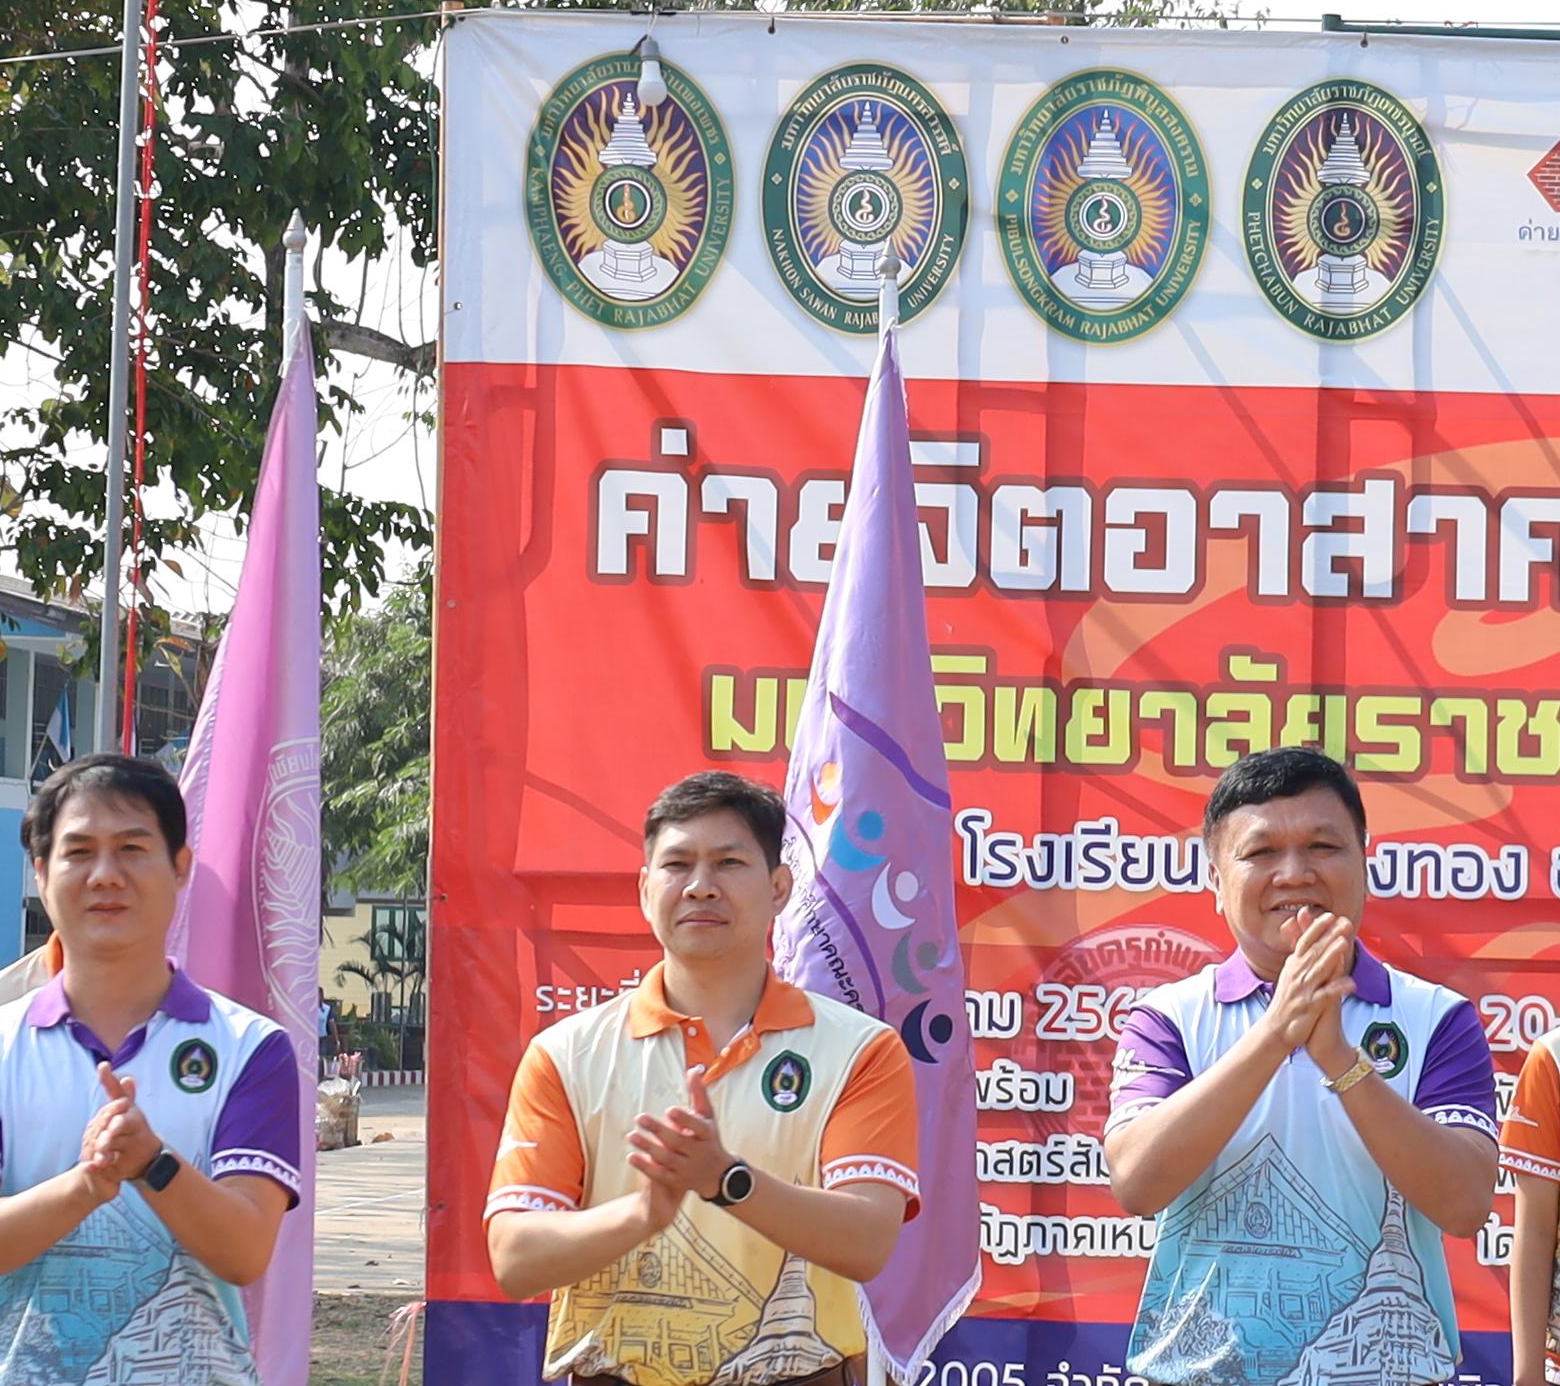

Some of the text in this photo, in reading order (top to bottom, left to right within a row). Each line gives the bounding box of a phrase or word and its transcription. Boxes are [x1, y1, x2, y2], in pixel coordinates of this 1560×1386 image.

[531, 167, 731, 326] KAMPHAENG PHET RAJABHAT UNIVERSITY
[772, 229, 802, 289] NAKHON
[799, 287, 838, 320] SAWAN
[907, 233, 956, 308] UNIVERSITY
[1005, 214, 1202, 339] PIBULSONGKRAM RAJABHAT UNIVERSITY
[1247, 212, 1441, 337] PHETCHABUN RAJABHAT UNIVERSITY
[1041, 987, 1132, 1035] 256
